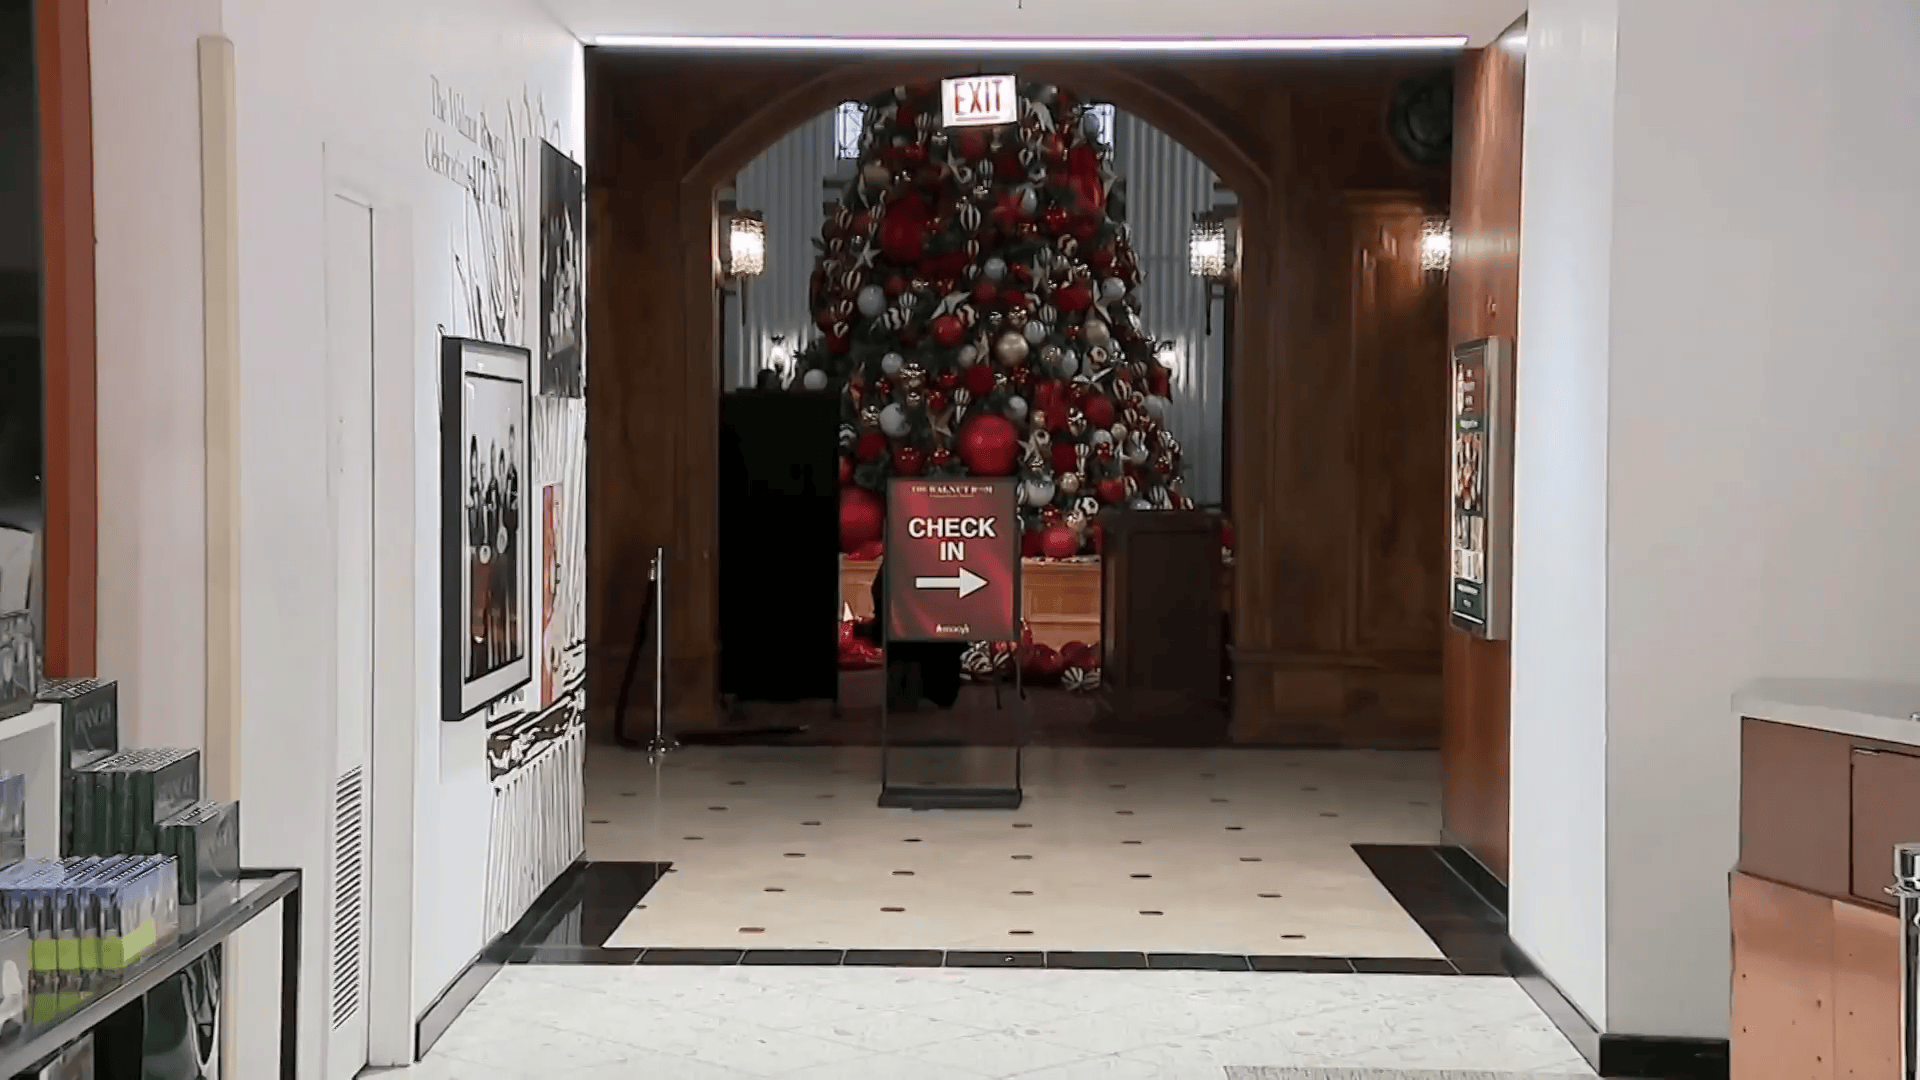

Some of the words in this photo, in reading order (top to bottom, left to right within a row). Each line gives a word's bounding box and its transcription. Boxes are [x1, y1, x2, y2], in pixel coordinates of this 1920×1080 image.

[954, 80, 1003, 115] EXIT
[971, 485, 993, 494] RM
[908, 517, 997, 538] CHECK
[940, 541, 964, 561] IN
